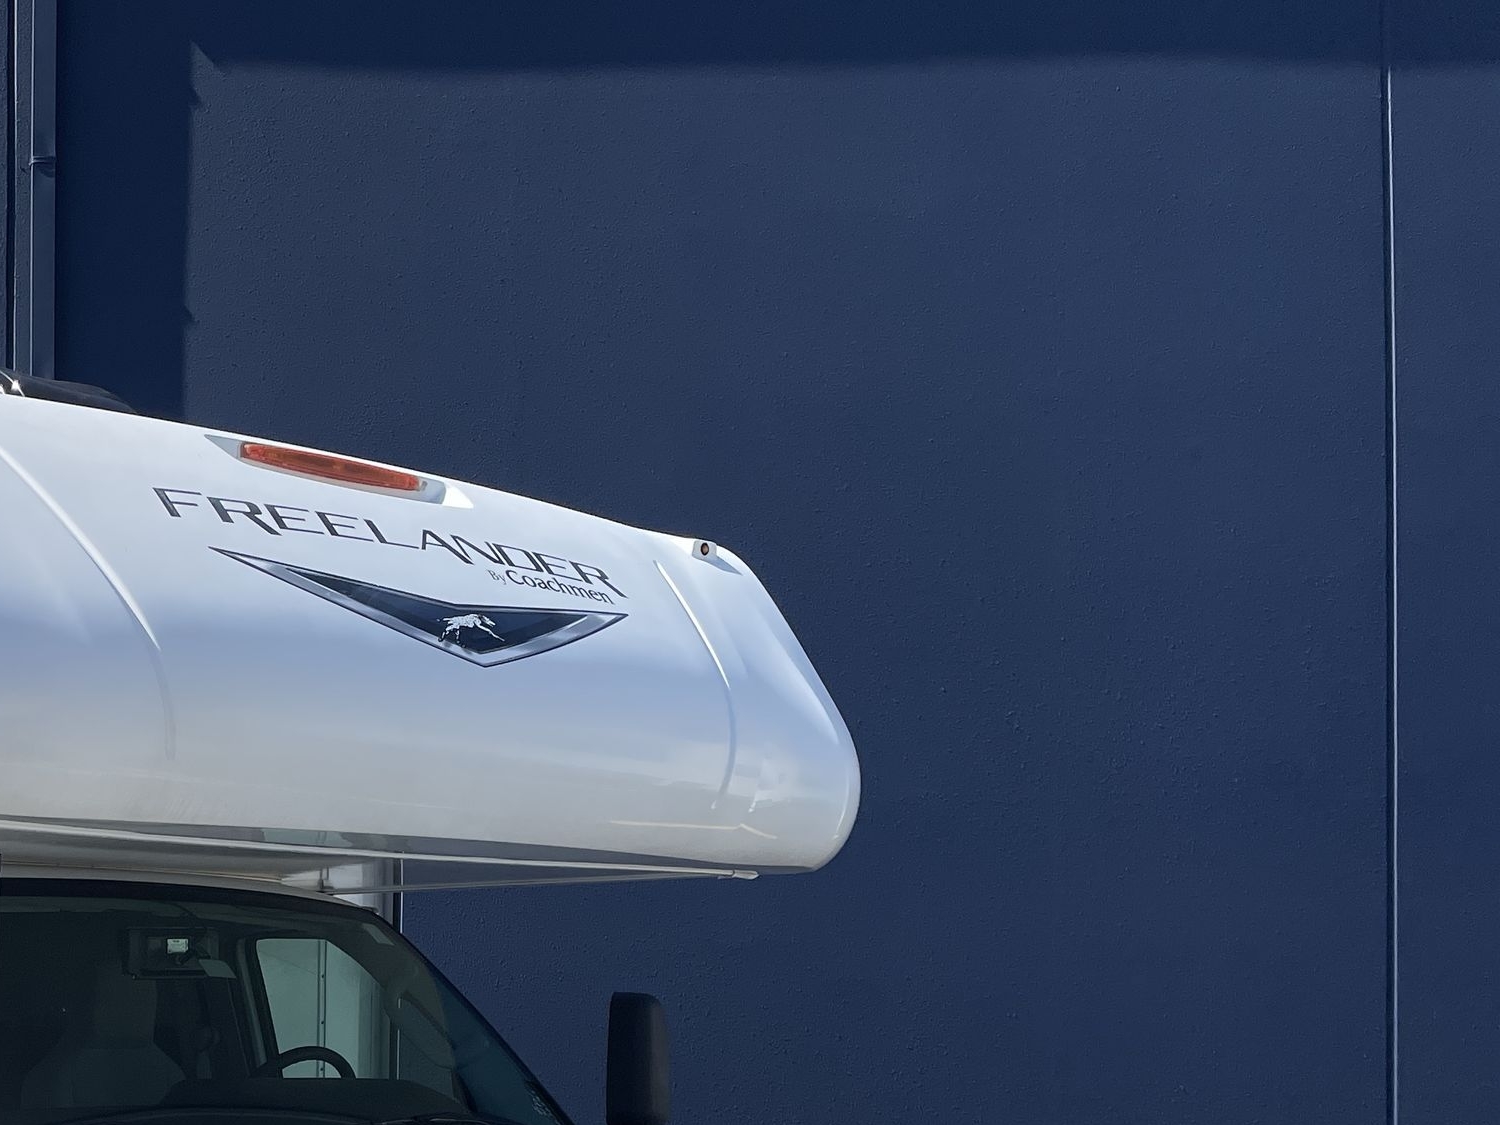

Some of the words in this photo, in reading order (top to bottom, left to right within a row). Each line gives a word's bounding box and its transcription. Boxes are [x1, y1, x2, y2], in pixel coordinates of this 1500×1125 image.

[152, 486, 629, 599] FREELANDER
[486, 569, 507, 586] By
[505, 569, 615, 605] Coachmen
